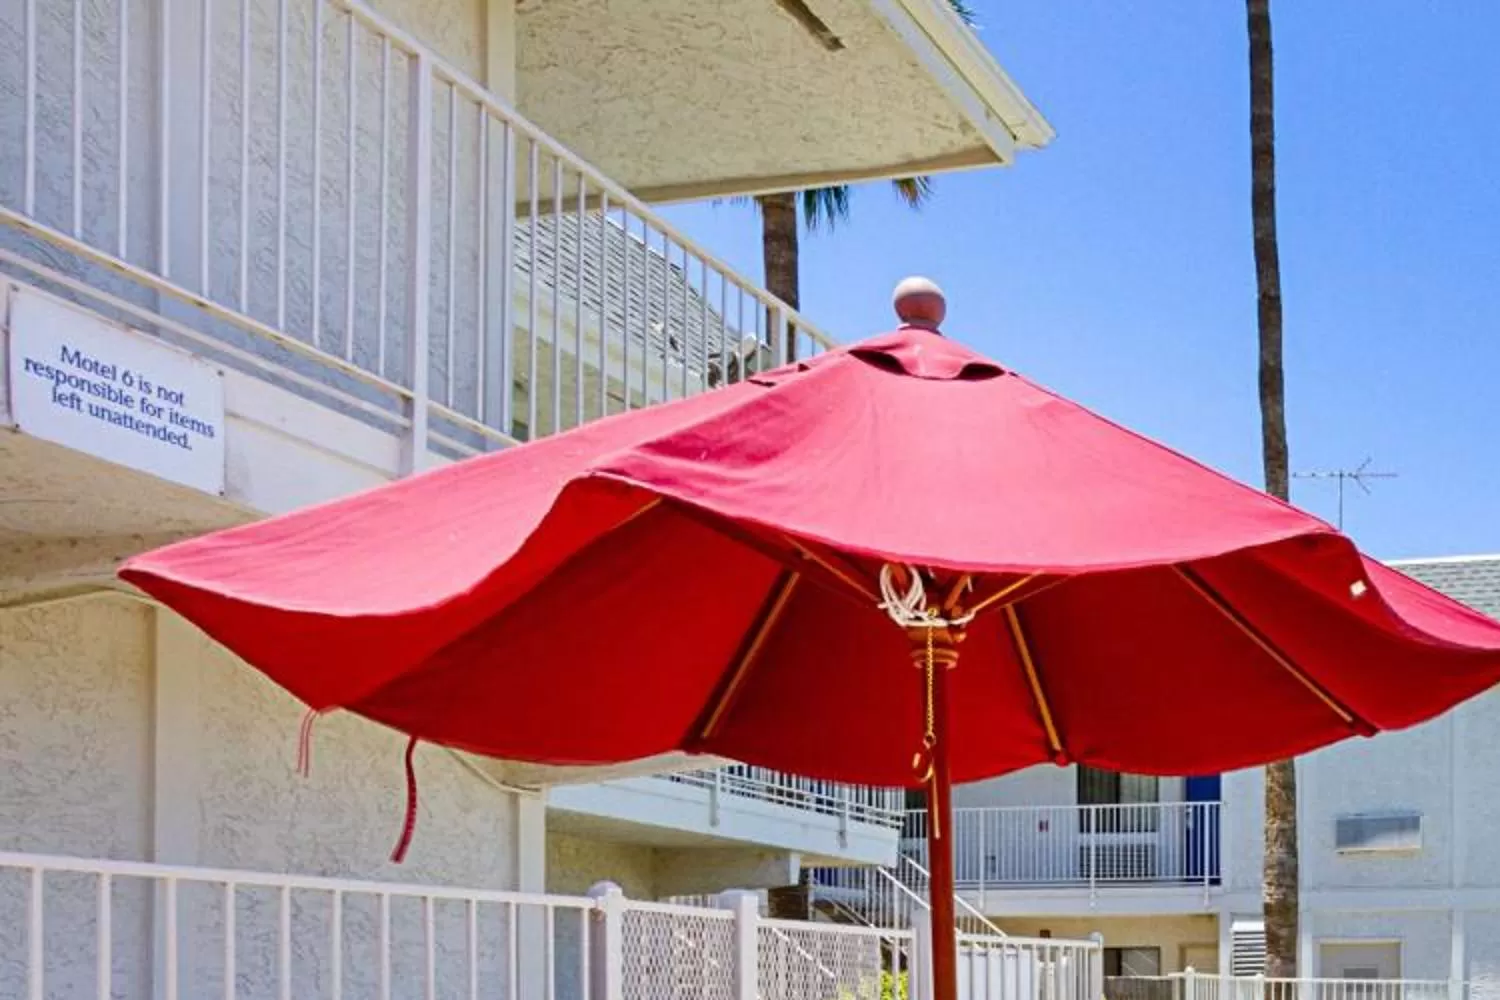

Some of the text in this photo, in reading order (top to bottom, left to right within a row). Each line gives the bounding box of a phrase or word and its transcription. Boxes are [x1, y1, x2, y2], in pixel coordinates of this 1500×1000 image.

[24, 357, 216, 438] responsible for items
[60, 345, 185, 406] Motel 6 is not
[52, 387, 193, 450] left unattended.
